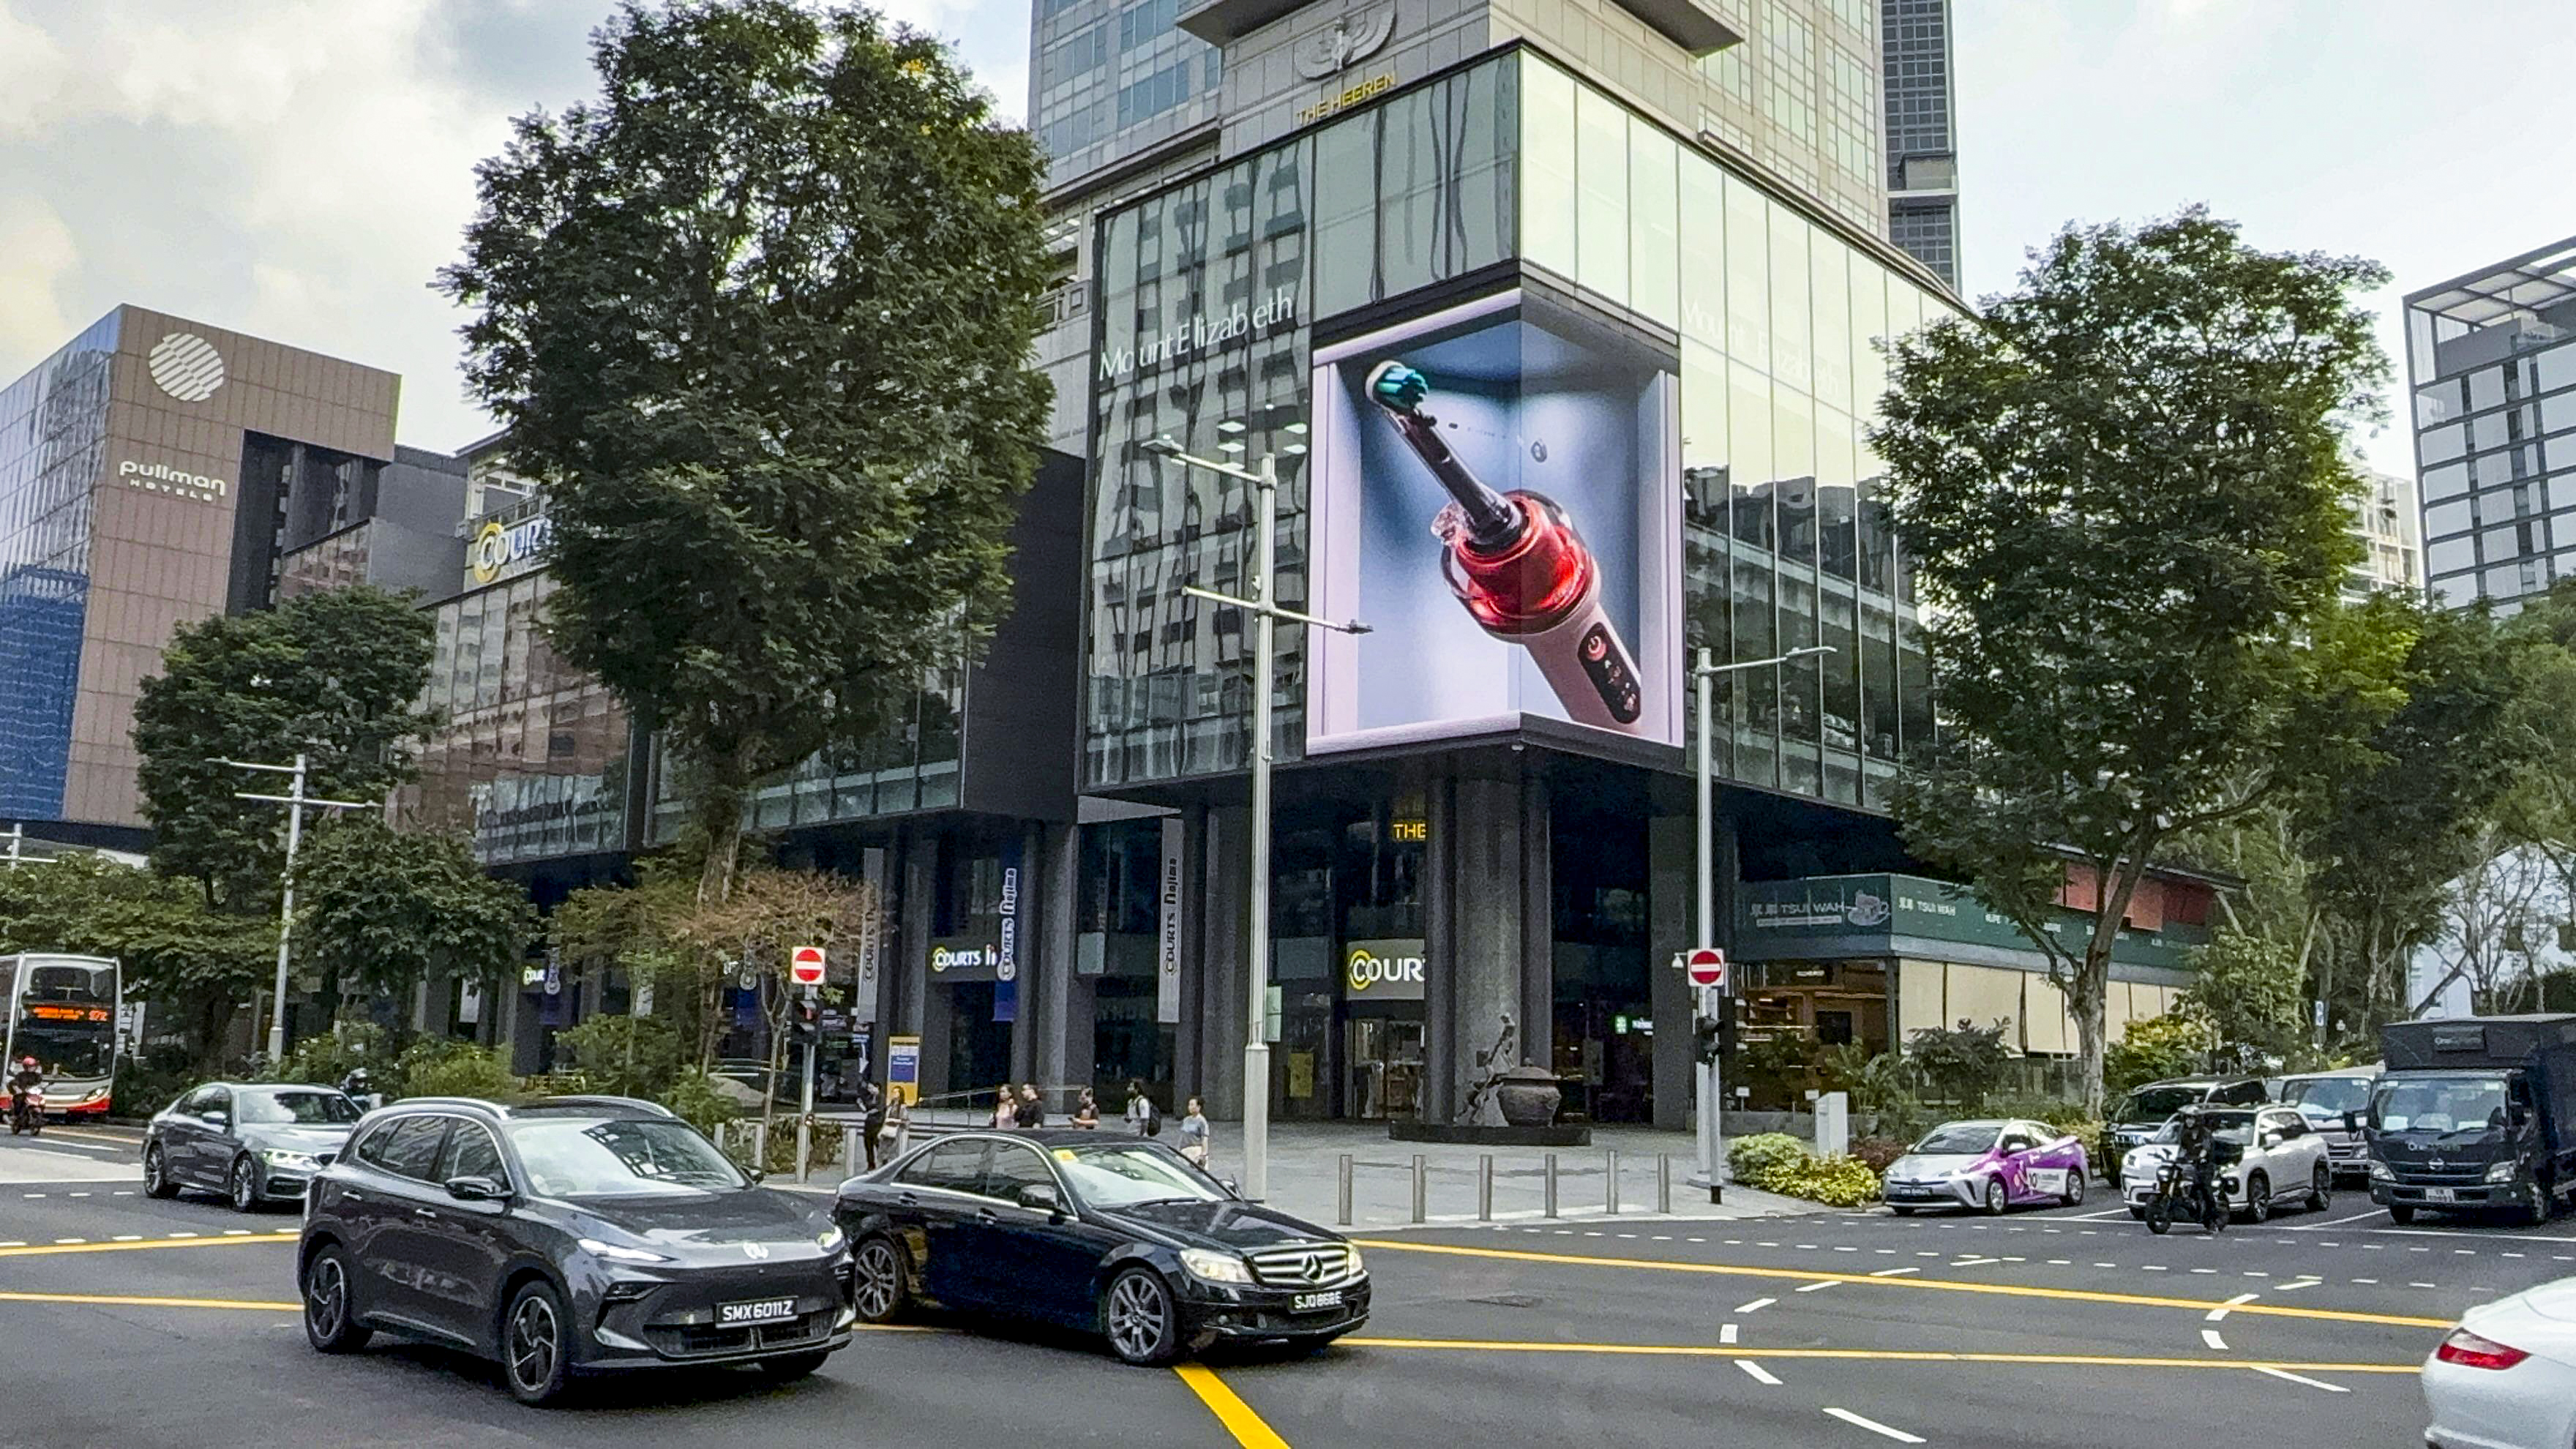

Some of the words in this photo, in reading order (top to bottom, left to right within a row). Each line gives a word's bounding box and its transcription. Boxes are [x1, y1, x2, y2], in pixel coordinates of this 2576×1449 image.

[1296, 100, 1328, 126] THE
[1330, 70, 1397, 109] HEEREN
[1099, 332, 1174, 381] Mount
[1177, 287, 1293, 355] Elizabeth
[119, 460, 226, 496] pullman
[130, 479, 213, 502] HOTELS
[479, 518, 553, 572] COUR
[1393, 823, 1426, 839] THE
[1164, 858, 1178, 905] Nojima
[1781, 904, 1811, 915] TSUI
[1813, 902, 1844, 913] WAH
[934, 949, 982, 967] COURTS
[1001, 918, 1015, 978] COURTS
[1164, 913, 1176, 973] COURTS
[1352, 955, 1425, 984] COUR
[722, 1300, 794, 1322] SMX6011Z
